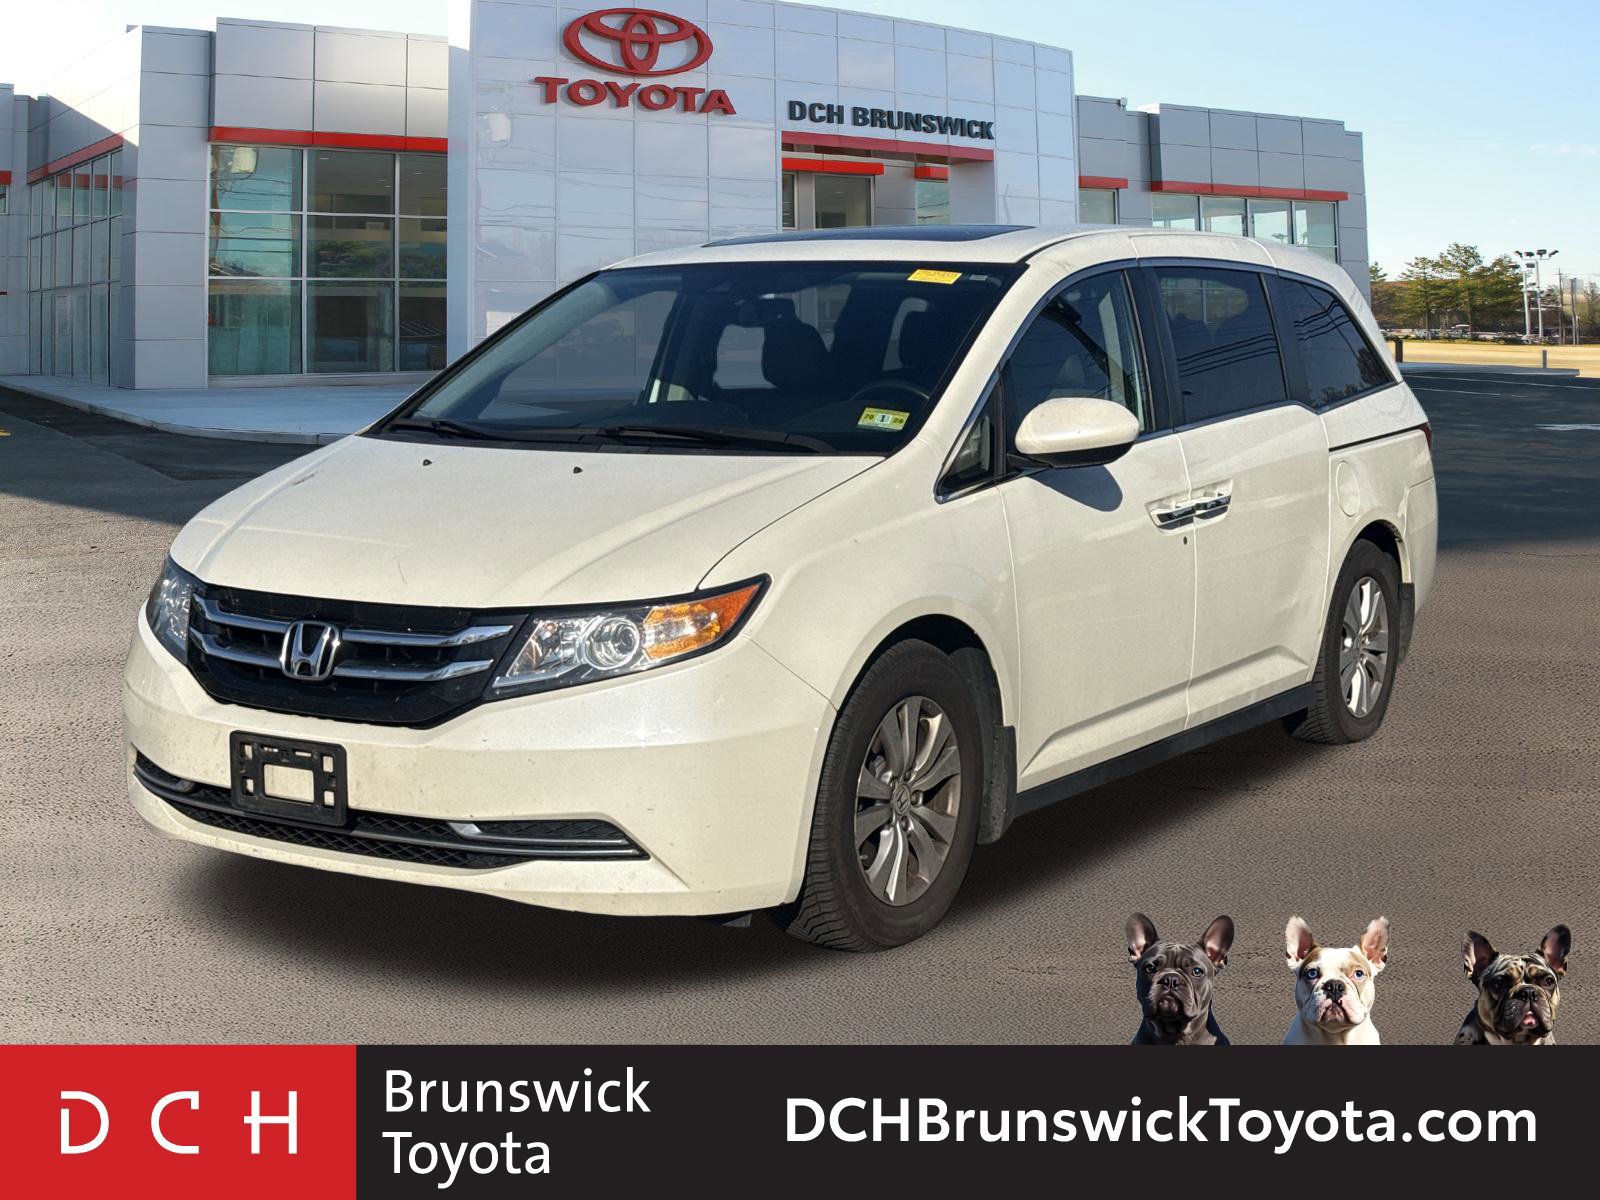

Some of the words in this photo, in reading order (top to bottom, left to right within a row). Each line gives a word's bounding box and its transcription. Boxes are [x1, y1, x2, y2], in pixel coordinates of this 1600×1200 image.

[534, 76, 737, 115] TOYOTA
[788, 100, 845, 126] DCH
[852, 106, 995, 141] BRUNSWICK
